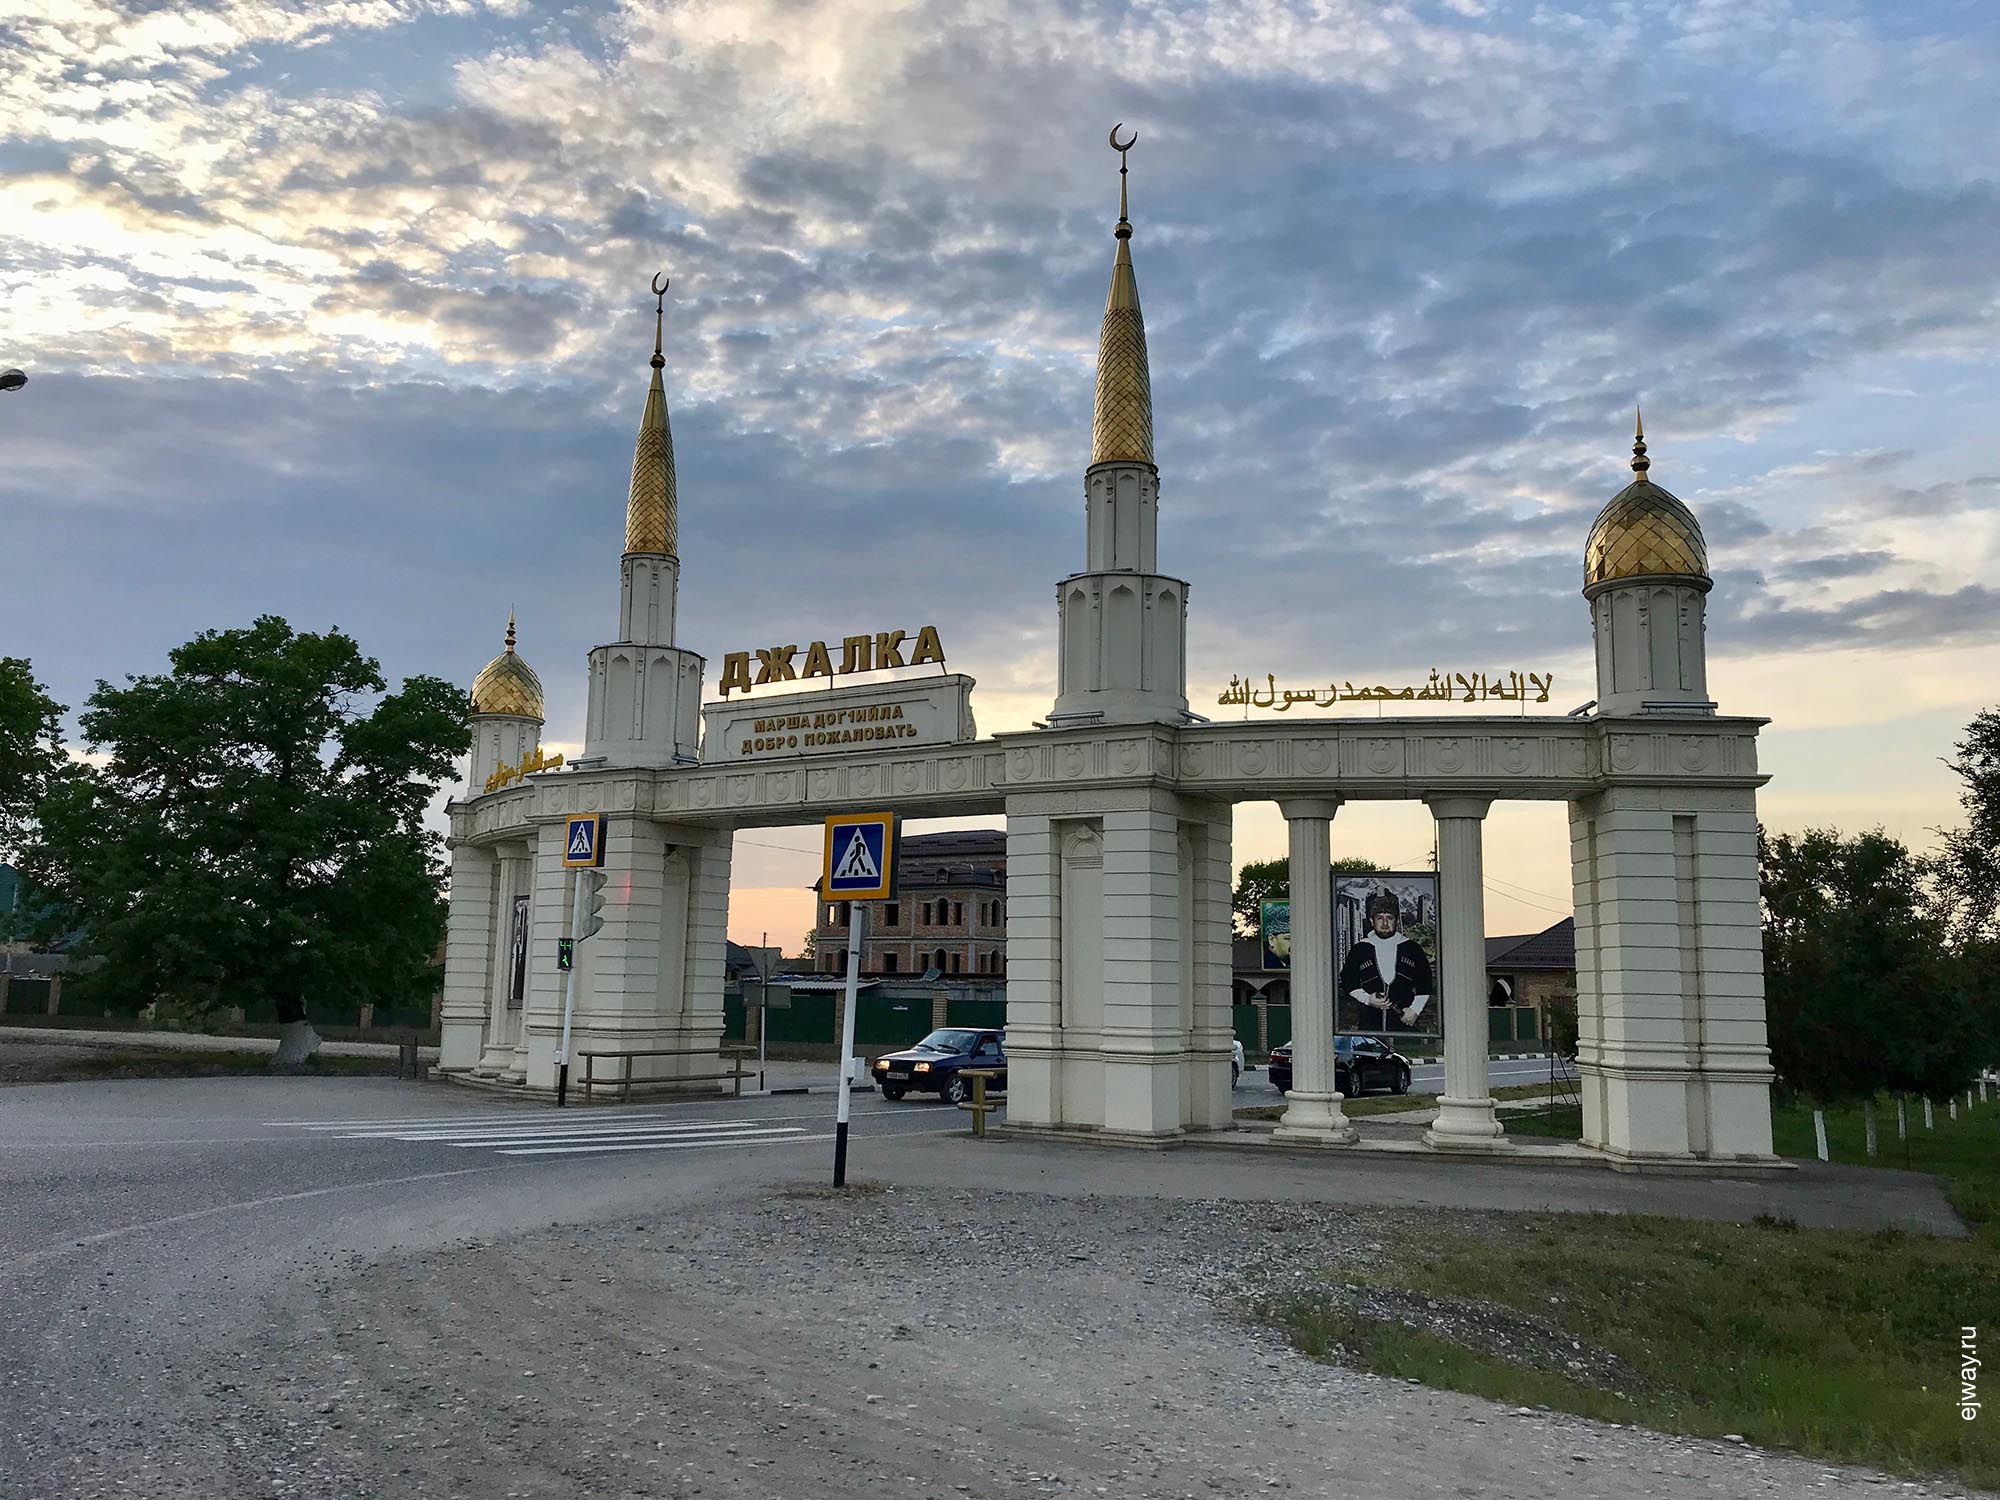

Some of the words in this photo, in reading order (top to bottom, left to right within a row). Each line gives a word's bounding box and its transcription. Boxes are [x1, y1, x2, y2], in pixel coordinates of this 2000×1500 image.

[719, 625, 946, 695] ДЖАЛКА
[1529, 672, 1553, 702] لا
[754, 713, 811, 733] МАРША
[741, 734, 798, 755] ДОБРО
[804, 723, 918, 747] ПОЖАЛОВАТЬ
